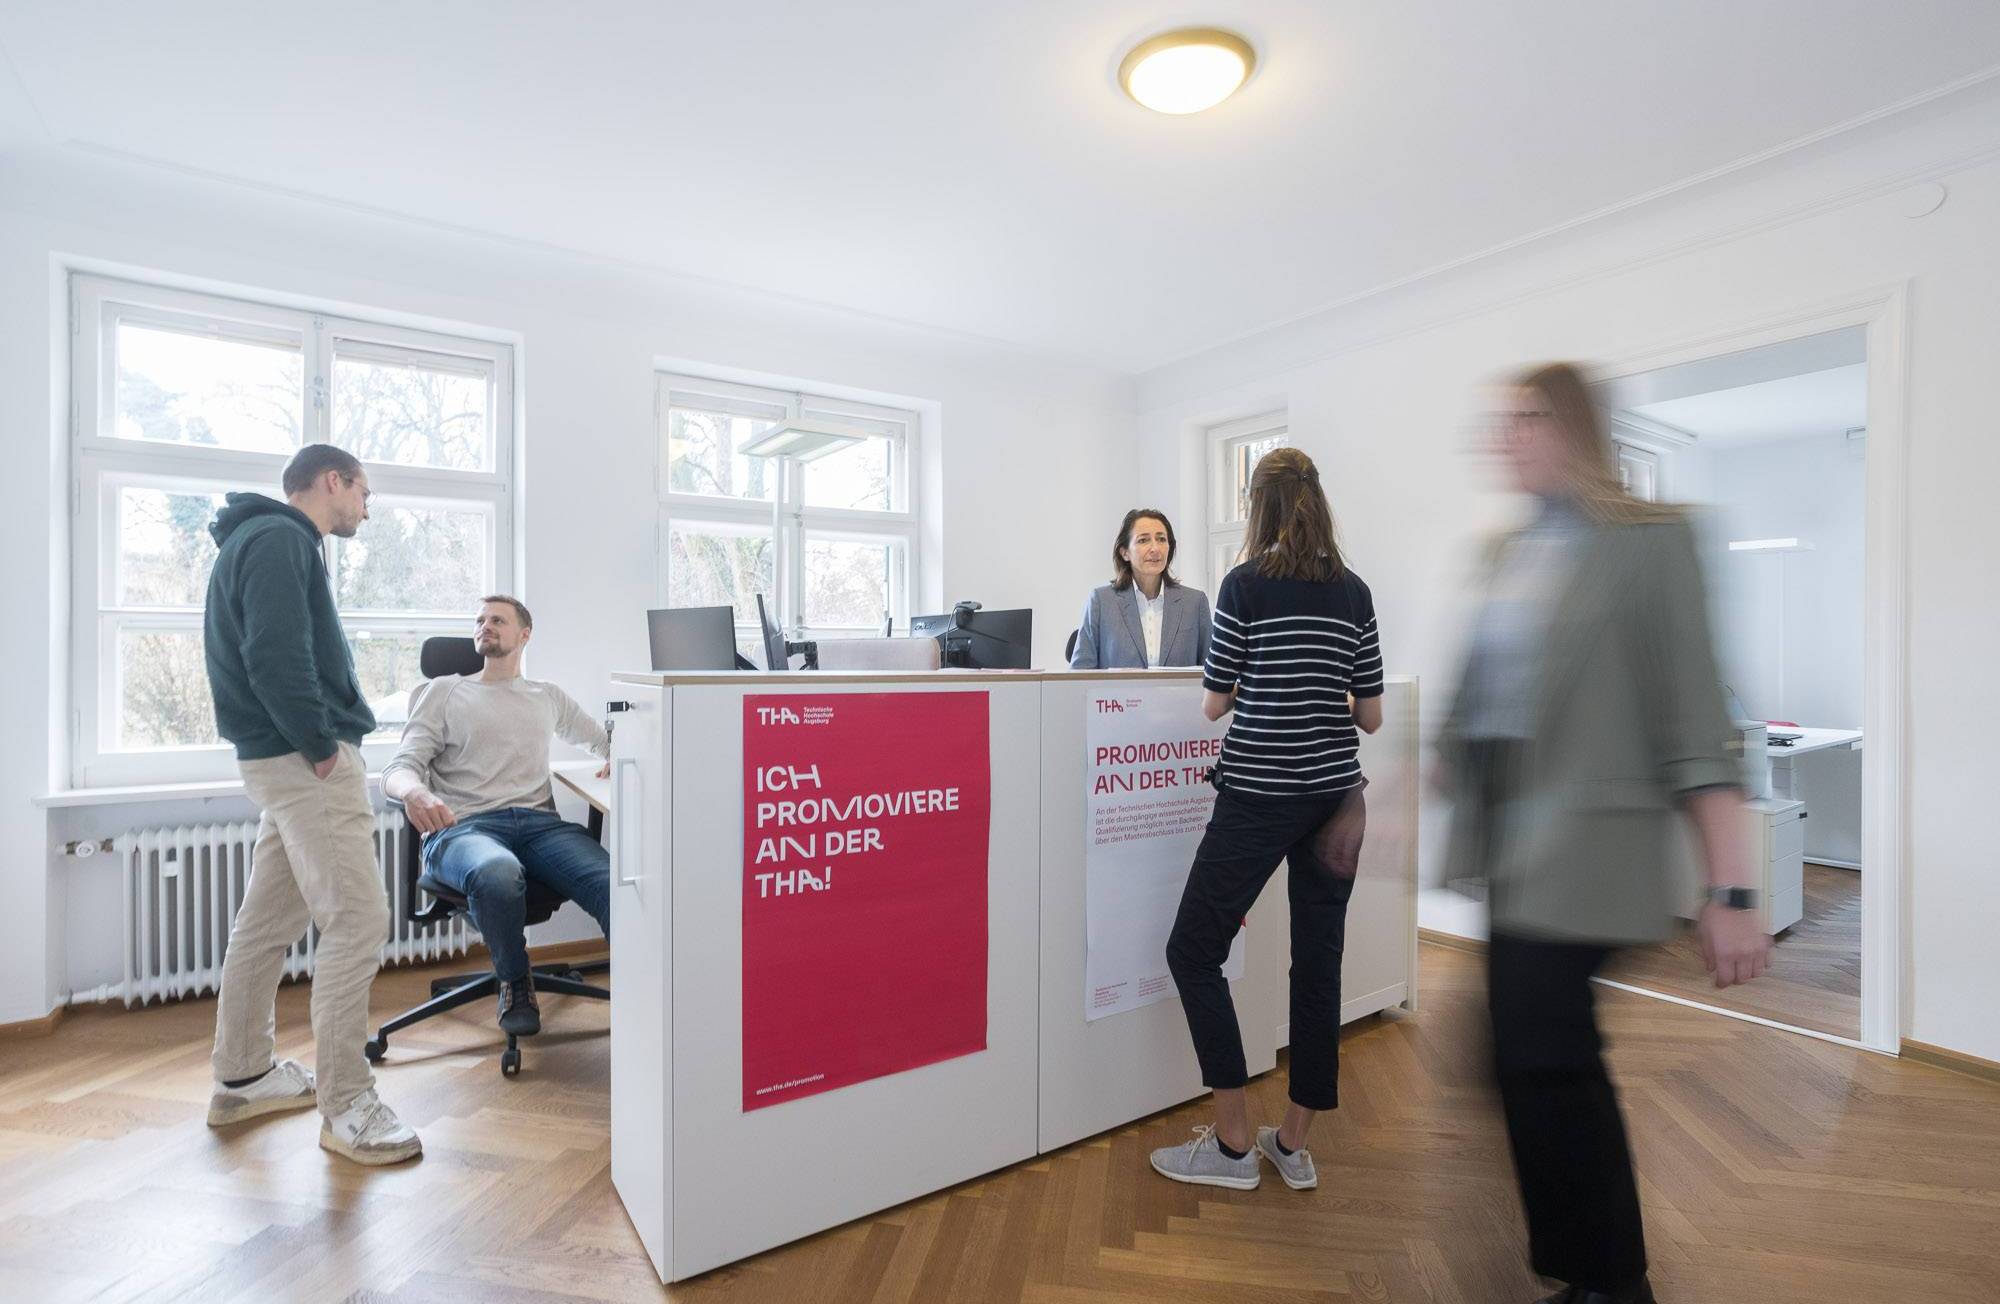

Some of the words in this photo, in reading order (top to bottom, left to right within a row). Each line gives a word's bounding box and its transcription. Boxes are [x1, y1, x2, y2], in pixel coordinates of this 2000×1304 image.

[757, 764, 822, 793] ICH
[1094, 773, 1134, 796] AN
[1140, 769, 1179, 791] DER
[757, 787, 960, 829] PROMOVIERE
[755, 834, 816, 865] AN
[825, 828, 884, 857] DER
[755, 866, 832, 899] THA!
